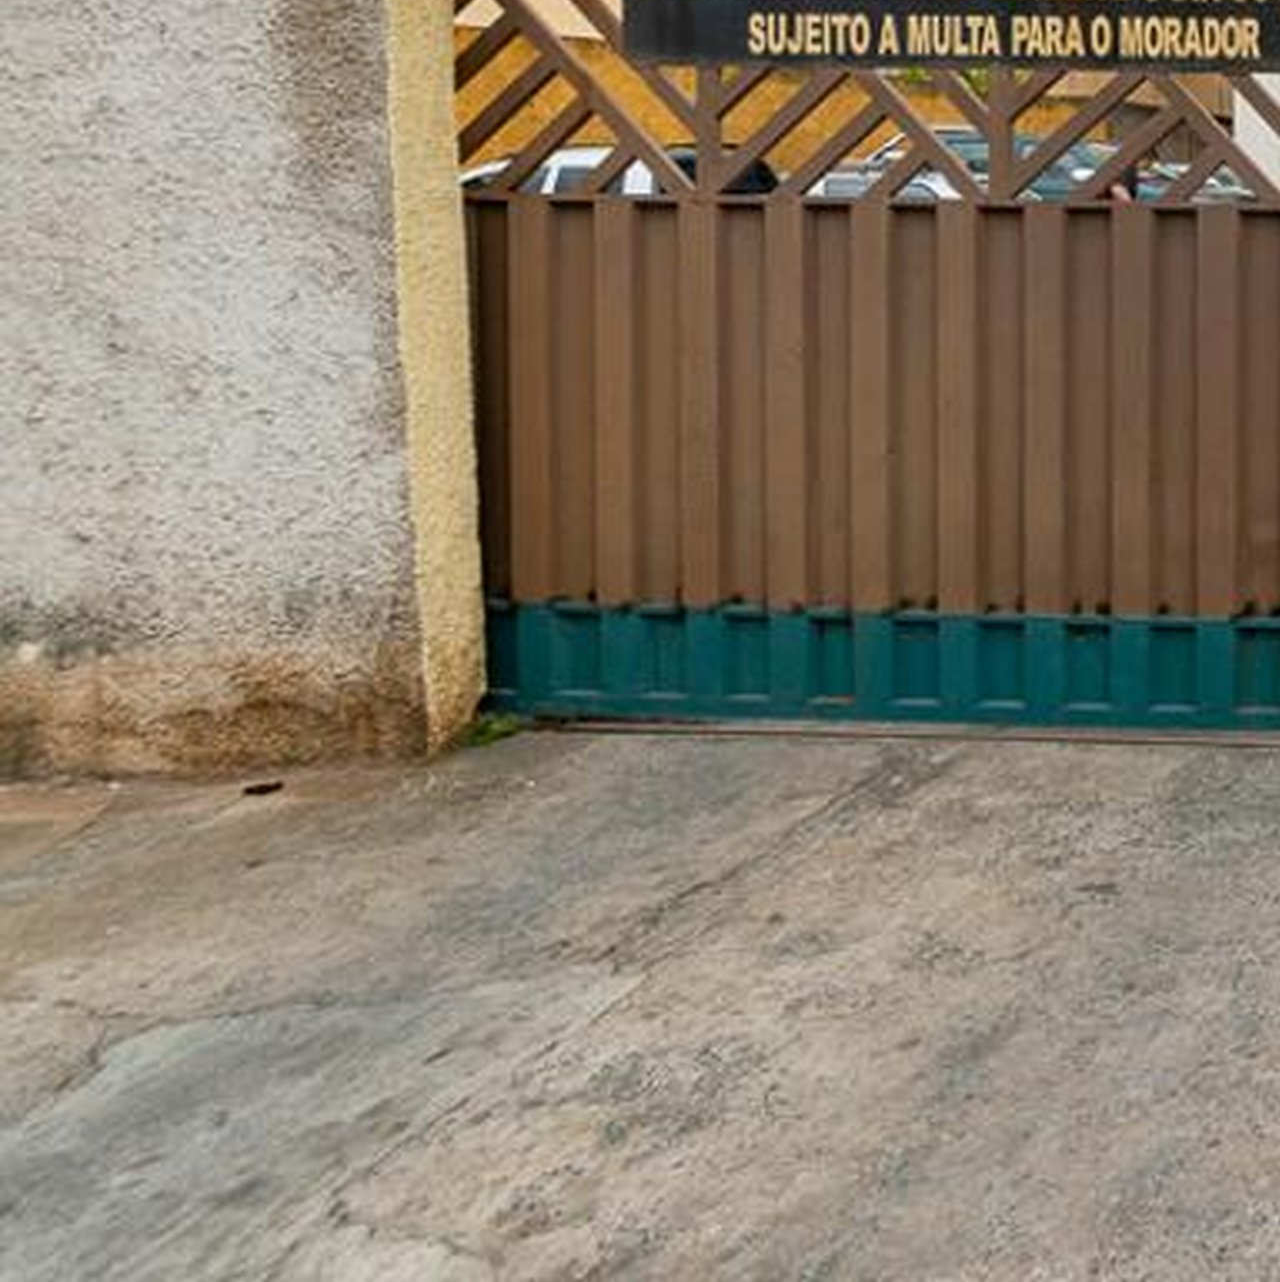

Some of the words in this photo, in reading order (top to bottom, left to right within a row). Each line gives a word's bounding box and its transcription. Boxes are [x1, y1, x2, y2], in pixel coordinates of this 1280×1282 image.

[748, 12, 871, 56] SUJEITO
[878, 14, 900, 56] A
[907, 14, 1002, 56] MULTA
[1011, 15, 1085, 57] PARA
[1091, 15, 1112, 57] O
[1119, 16, 1261, 59] MORADOR
